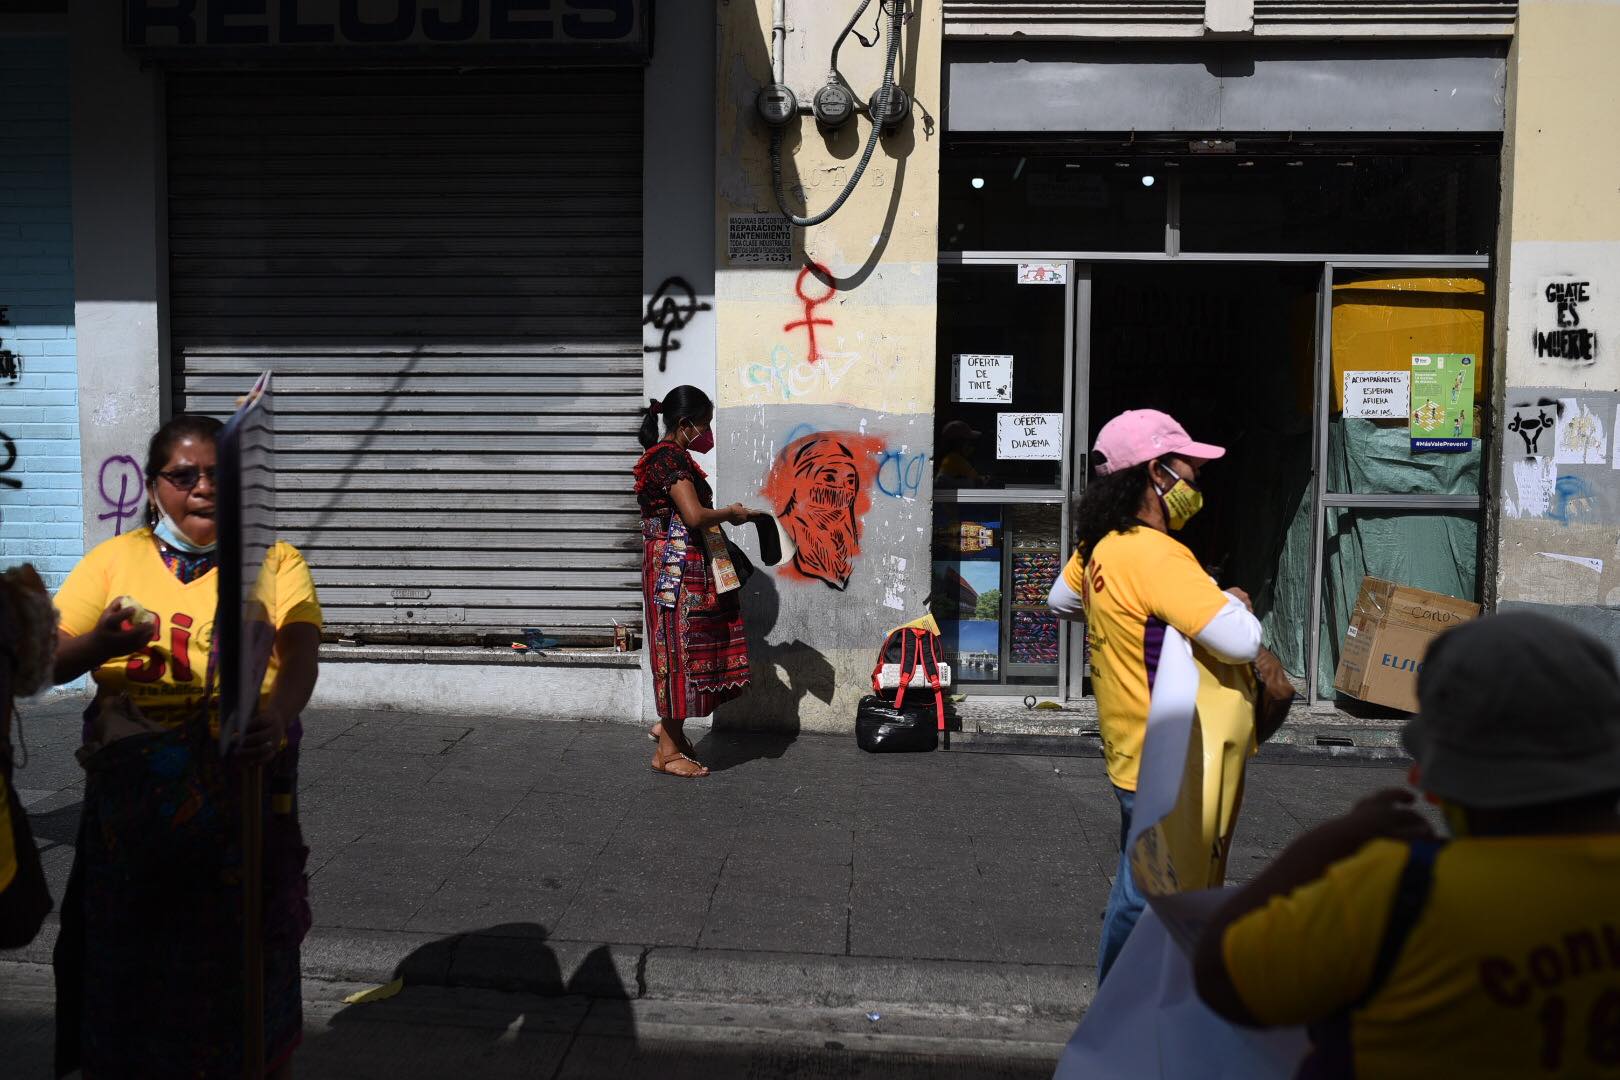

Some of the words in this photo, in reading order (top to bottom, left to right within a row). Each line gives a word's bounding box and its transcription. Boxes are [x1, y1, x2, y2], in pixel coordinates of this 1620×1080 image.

[132, 0, 635, 44] RELOJES
[730, 231, 791, 239] MANTENIMIENTO
[968, 357, 1000, 367] OFERTA
[975, 369, 988, 379] DE
[968, 381, 992, 390] TINTE
[1013, 416, 1047, 426] OFERTA
[1024, 427, 1038, 437] DE
[1011, 439, 1051, 449] DIADEMA
